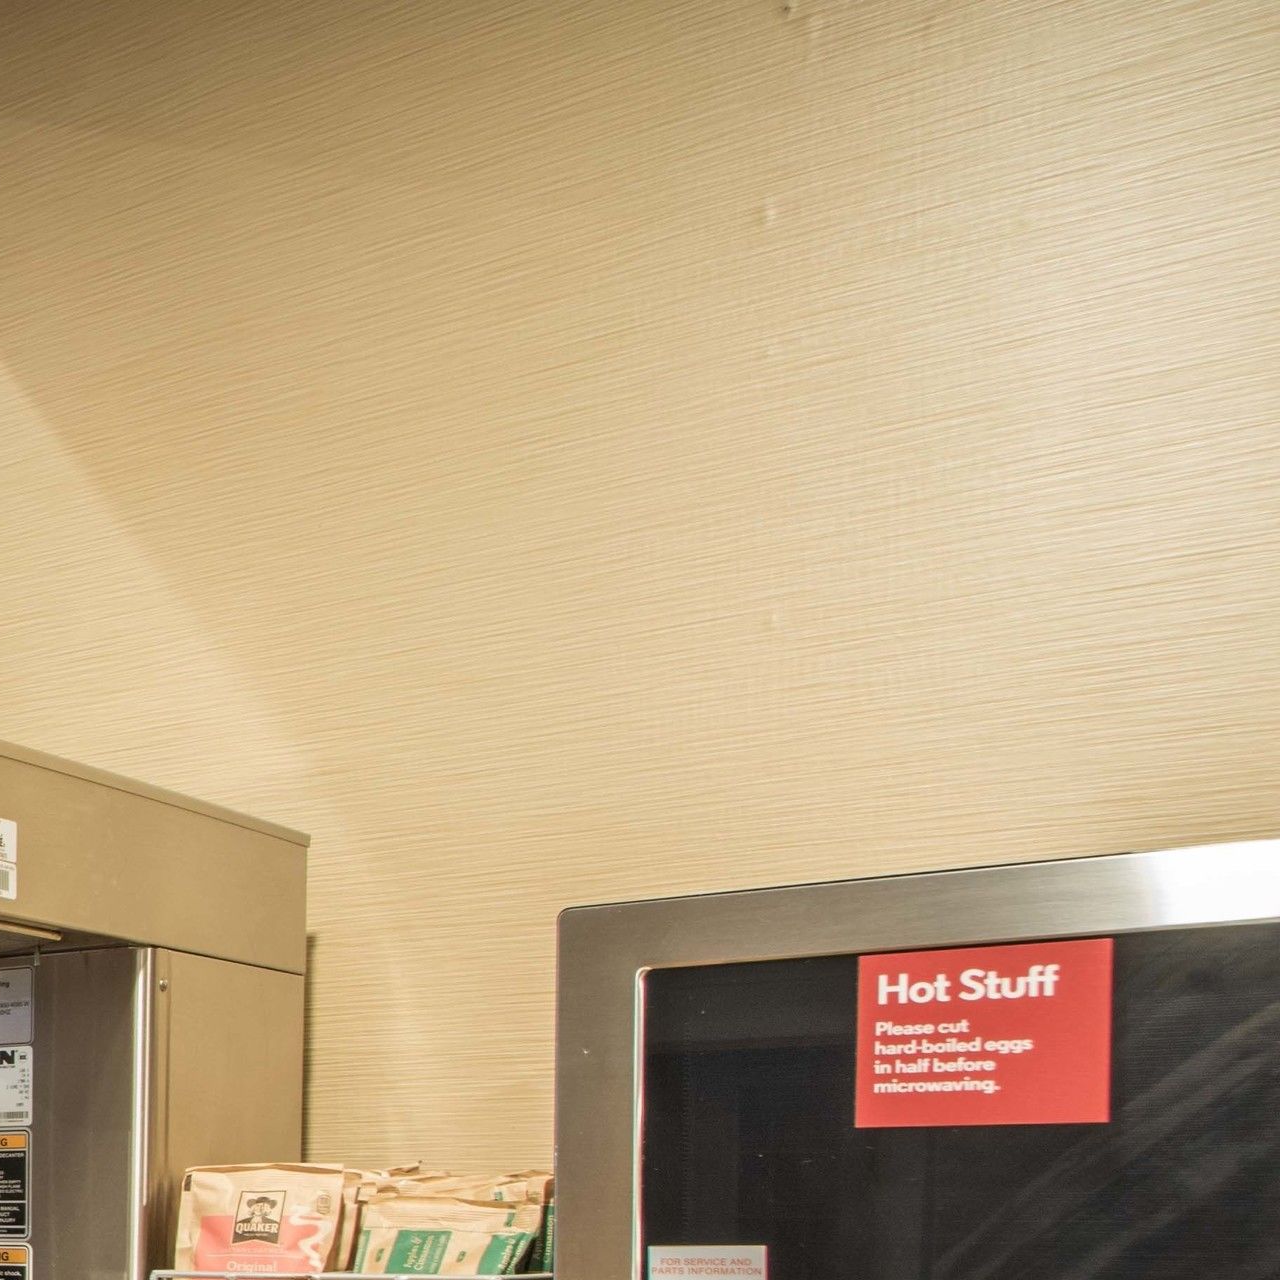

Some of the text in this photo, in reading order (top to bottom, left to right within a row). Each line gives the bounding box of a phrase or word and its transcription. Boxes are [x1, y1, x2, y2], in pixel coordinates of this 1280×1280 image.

[877, 963, 1061, 1005] Hot Stuff
[875, 1018, 971, 1036] Please cut
[873, 1036, 1034, 1056] hard-boiled eggs
[873, 1057, 996, 1075] in half before
[873, 1076, 1001, 1095] microwaving.
[235, 1222, 279, 1234] QUAKER
[226, 1261, 277, 1273] Original
[660, 1257, 752, 1266] FOR SERVICE AND
[652, 1267, 762, 1275] PARTS INFORMATION
